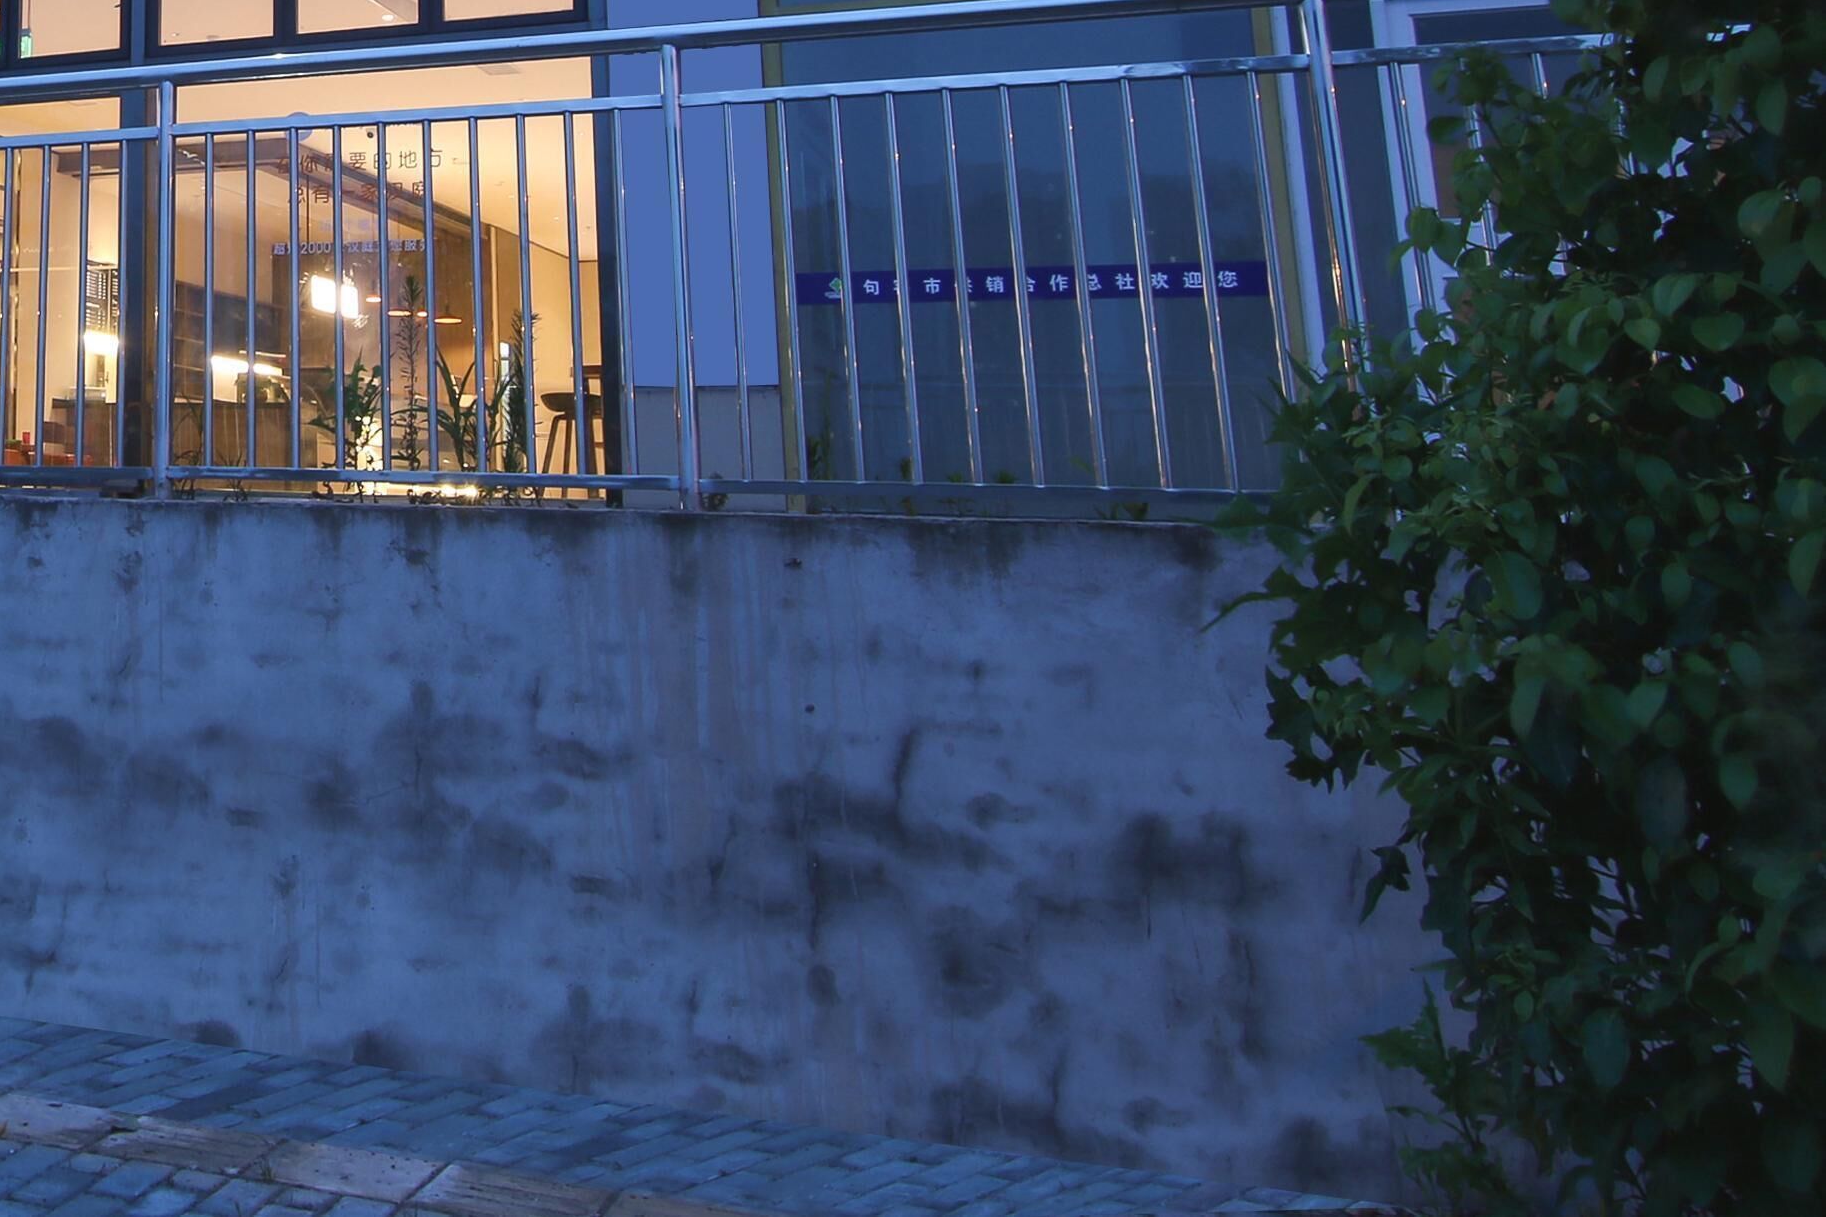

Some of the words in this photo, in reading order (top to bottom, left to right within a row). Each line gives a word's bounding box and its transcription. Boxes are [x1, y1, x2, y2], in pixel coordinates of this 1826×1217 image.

[863, 270, 1239, 296] 句市销合作总社欢迎您
